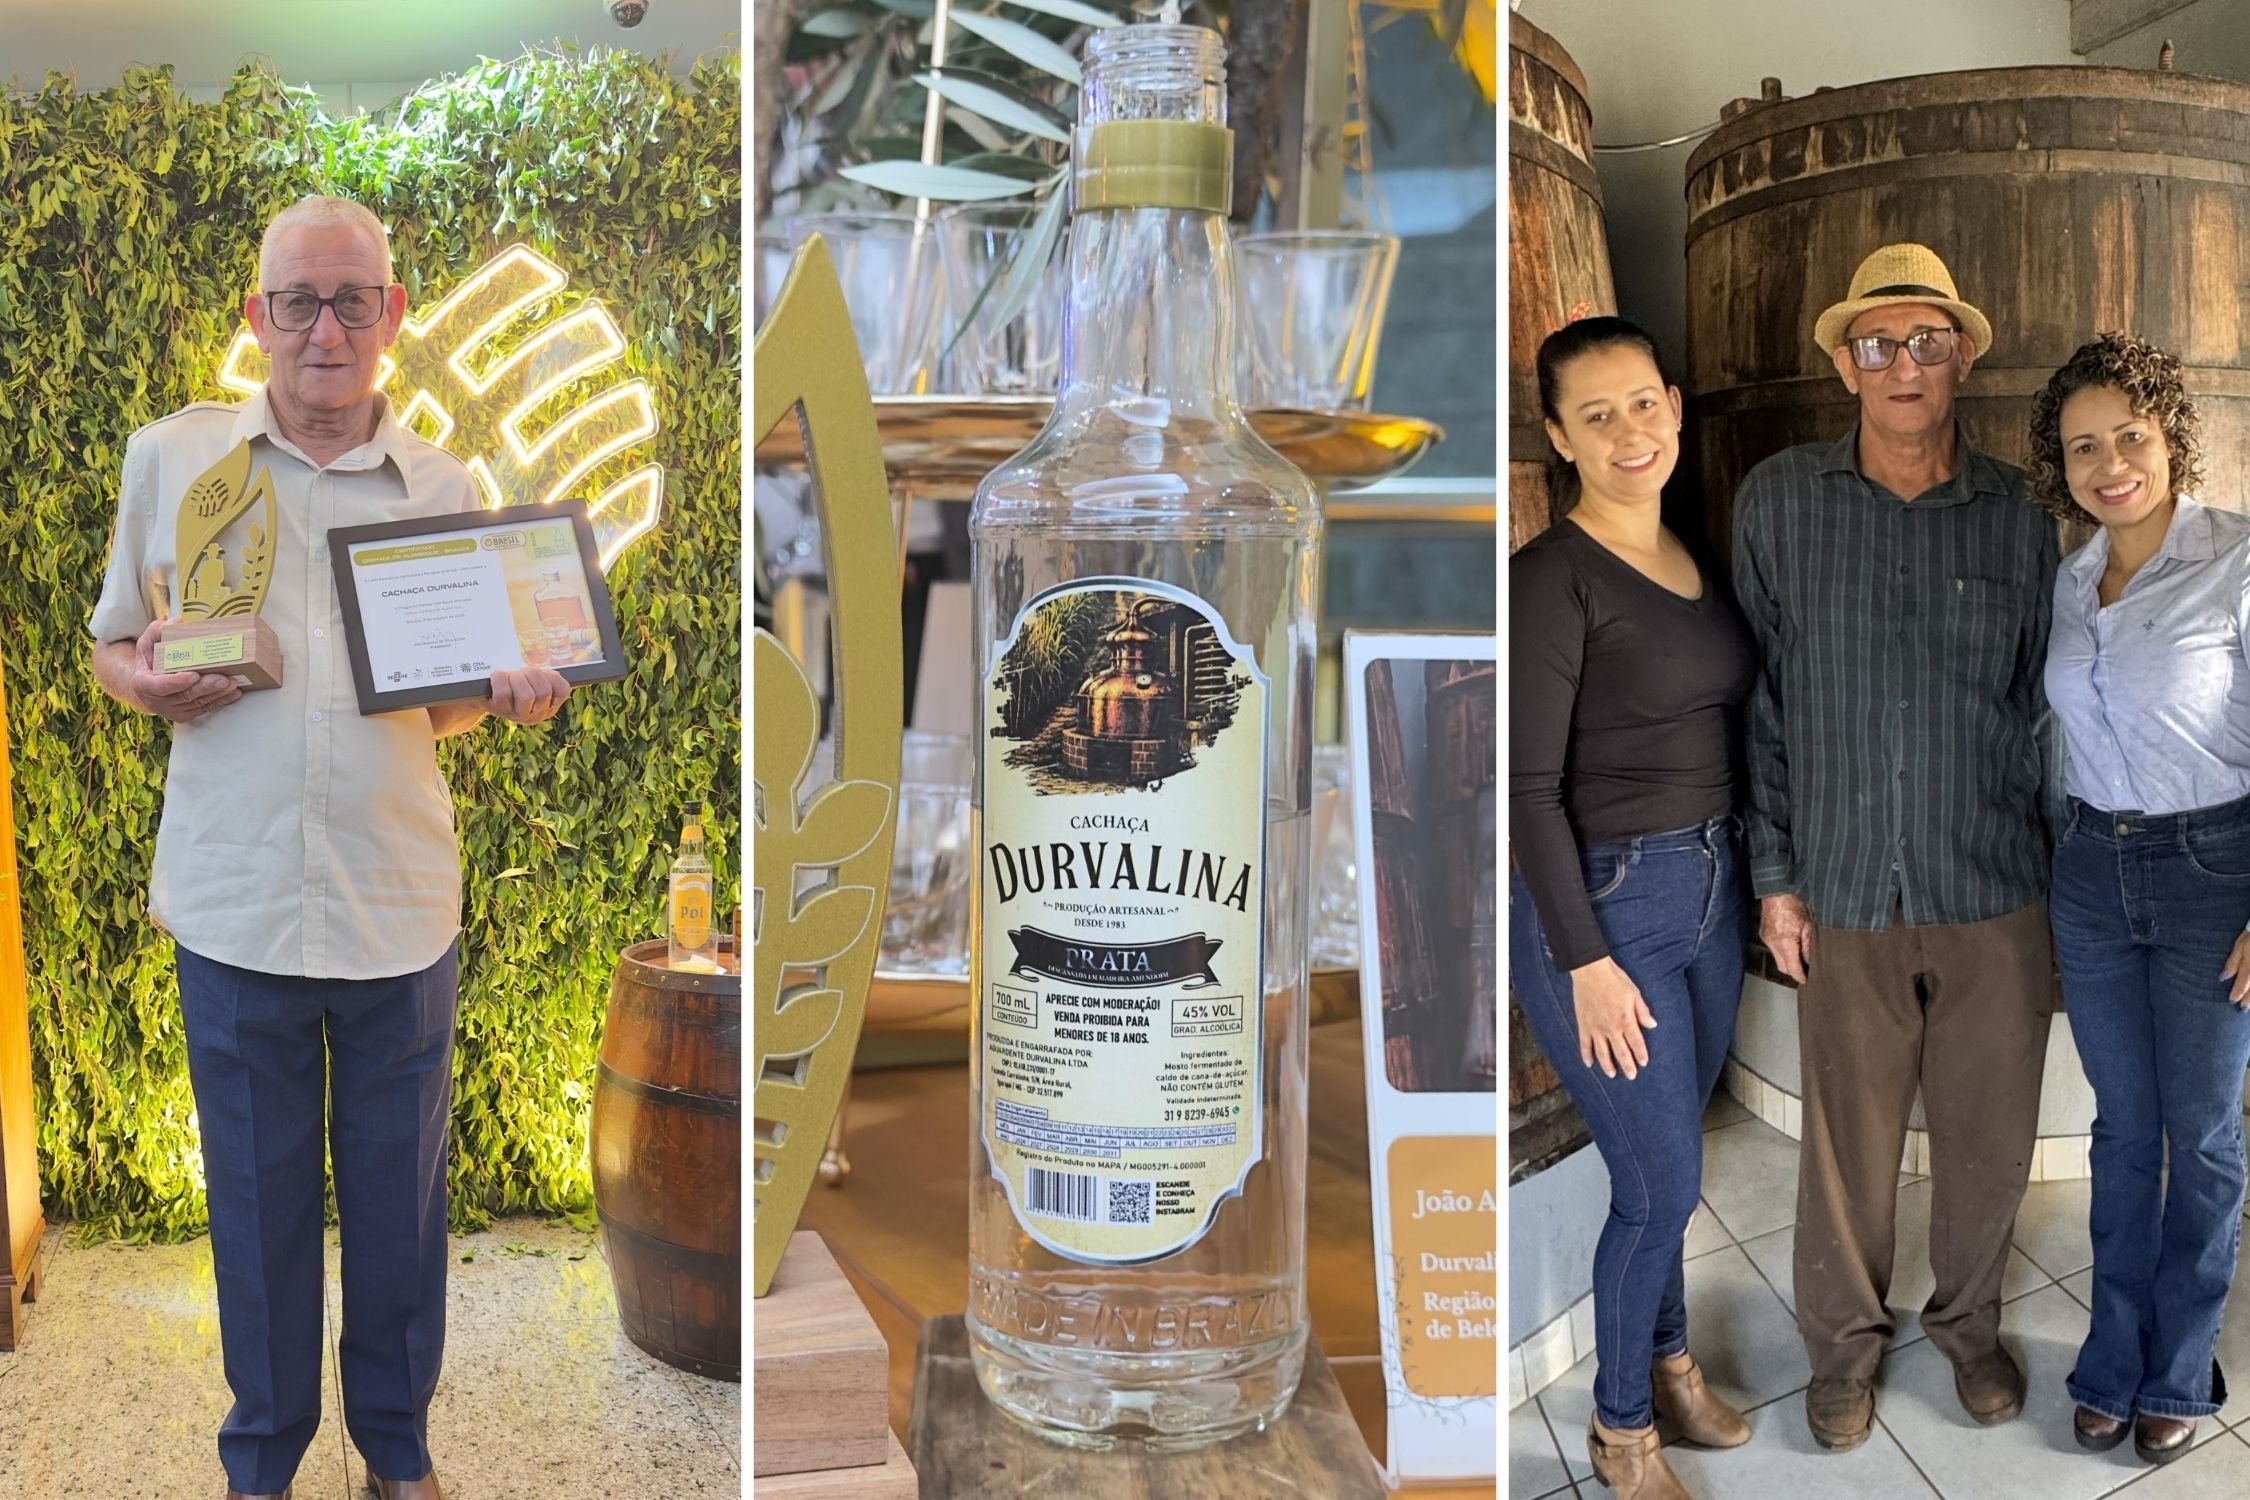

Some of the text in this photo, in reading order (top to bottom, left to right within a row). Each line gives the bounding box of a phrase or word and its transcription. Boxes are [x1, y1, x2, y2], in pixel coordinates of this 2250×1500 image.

[426, 580, 479, 592] DURVALINA
[1070, 815, 1150, 834] CACHAÇA
[988, 841, 1252, 913] DURVALINA
[1054, 902, 1166, 916] PRODUÇÃO ARTESANAL
[1074, 918, 1126, 930] DESDE 1983
[1065, 947, 1152, 972] PRATA
[996, 992, 1030, 1010] 700 mL
[1046, 993, 1161, 1012] APRECIE COM MODERAÇÃO!
[1054, 1011, 1150, 1027] VENDA PROIBIDA PARA
[1182, 1004, 1236, 1018] 45% VOL
[1054, 1028, 1150, 1044] MENORES DE 18 ANOS.
[1174, 1025, 1198, 1034] GRAD.
[1020, 1041, 1073, 1056] ENGARRAFADA
[1026, 1053, 1066, 1066] DURVALINA
[1068, 1059, 1088, 1068] LTDA
[1164, 1058, 1242, 1070] Mosto fermentado de
[1156, 1074, 1178, 1082] caldo
[1180, 1073, 1189, 1081] de
[1160, 1082, 1178, 1092] NÃO
[1180, 1081, 1213, 1092] CONTÉM
[1164, 1106, 1230, 1122] 31 9 8239-6945
[1046, 1130, 1060, 1140] MAR
[1084, 1136, 1097, 1145] MAI
[1104, 1138, 1117, 1146] JUN
[1164, 1139, 1177, 1147] SET
[1184, 1138, 1197, 1146] OUT
[1016, 1148, 1042, 1160] Registro
[1054, 1156, 1084, 1167] Produto
[1098, 1162, 1121, 1170] MAPA
[1162, 1189, 1195, 1198] CONHEÇA
[1412, 1189, 1472, 1219] João
[1423, 1290, 1496, 1316] Região
[1425, 1318, 1452, 1339] de
